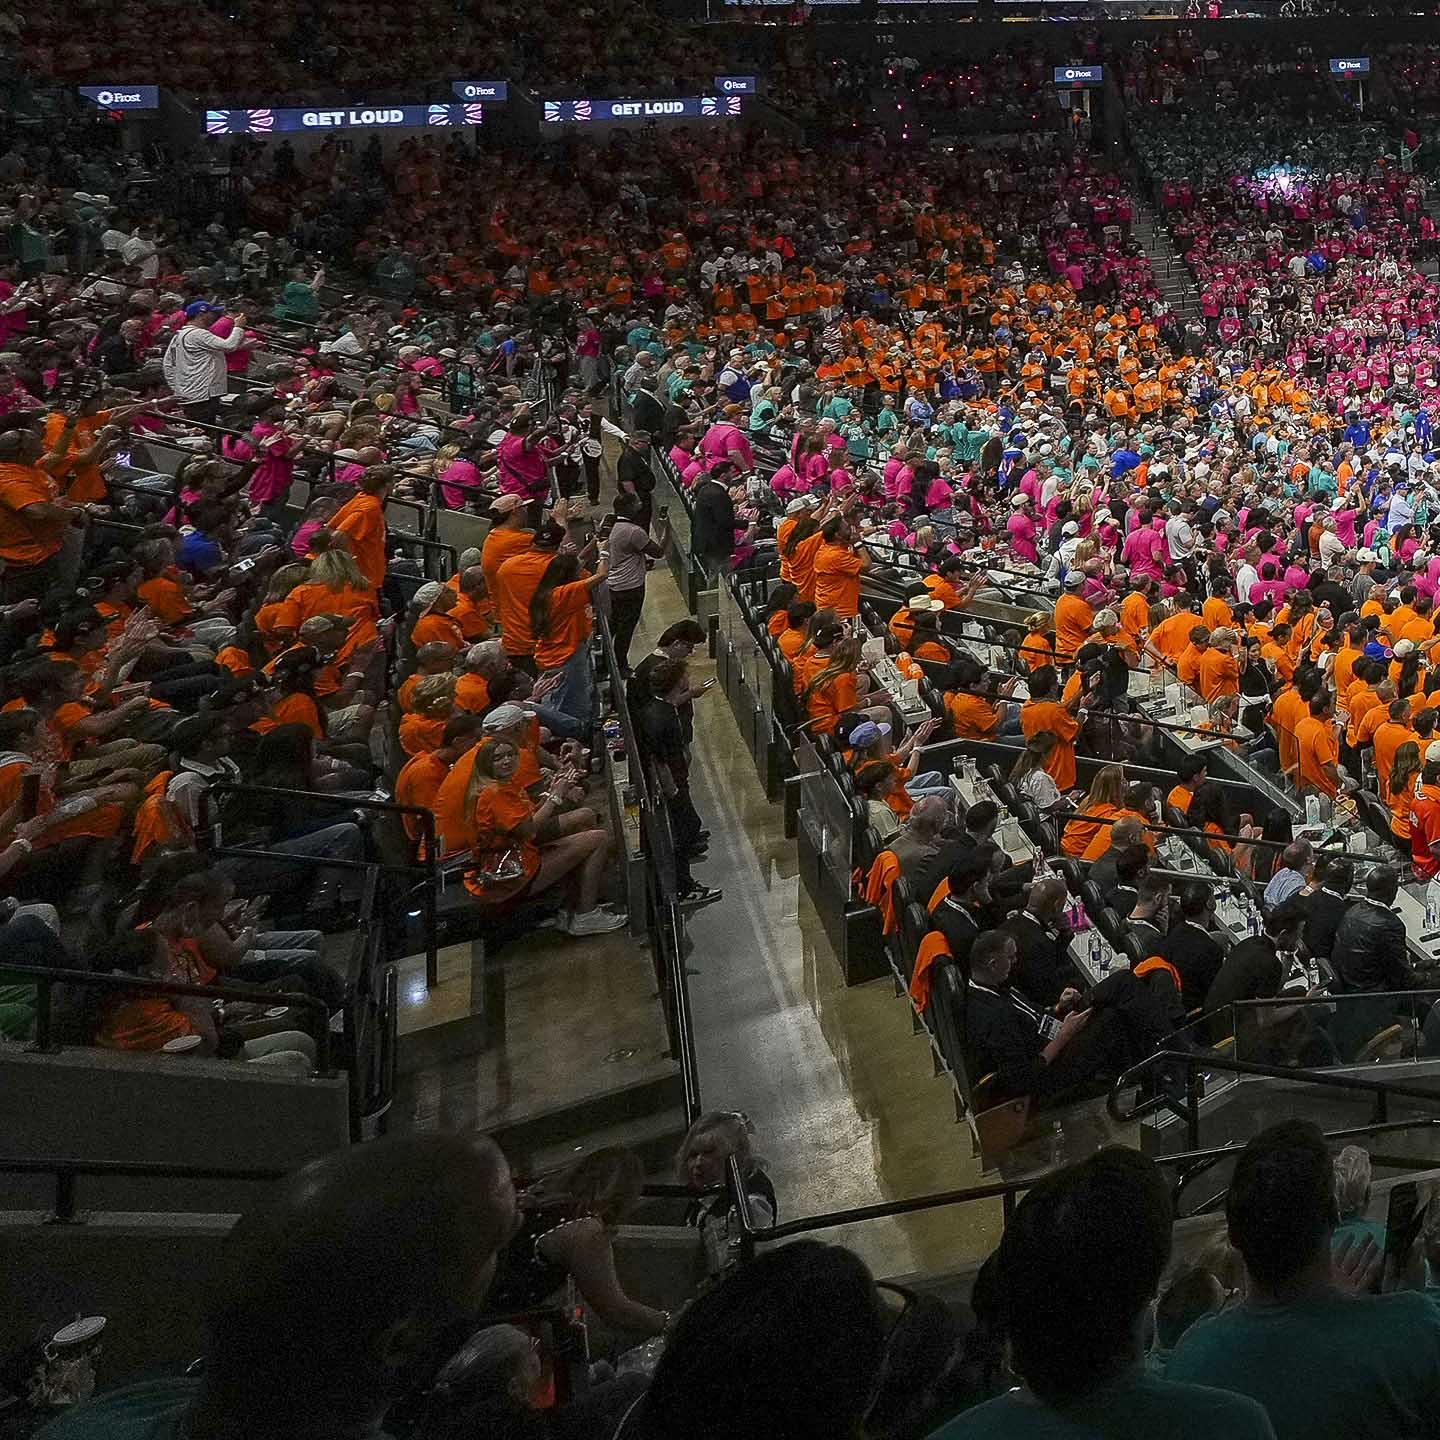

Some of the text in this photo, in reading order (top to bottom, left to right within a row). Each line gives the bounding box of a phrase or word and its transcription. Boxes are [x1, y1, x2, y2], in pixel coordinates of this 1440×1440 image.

[476, 86, 495, 95] Frost
[113, 93, 141, 102] Frost
[611, 102, 684, 116] GET LOUD
[302, 109, 404, 127] GET LOUD
